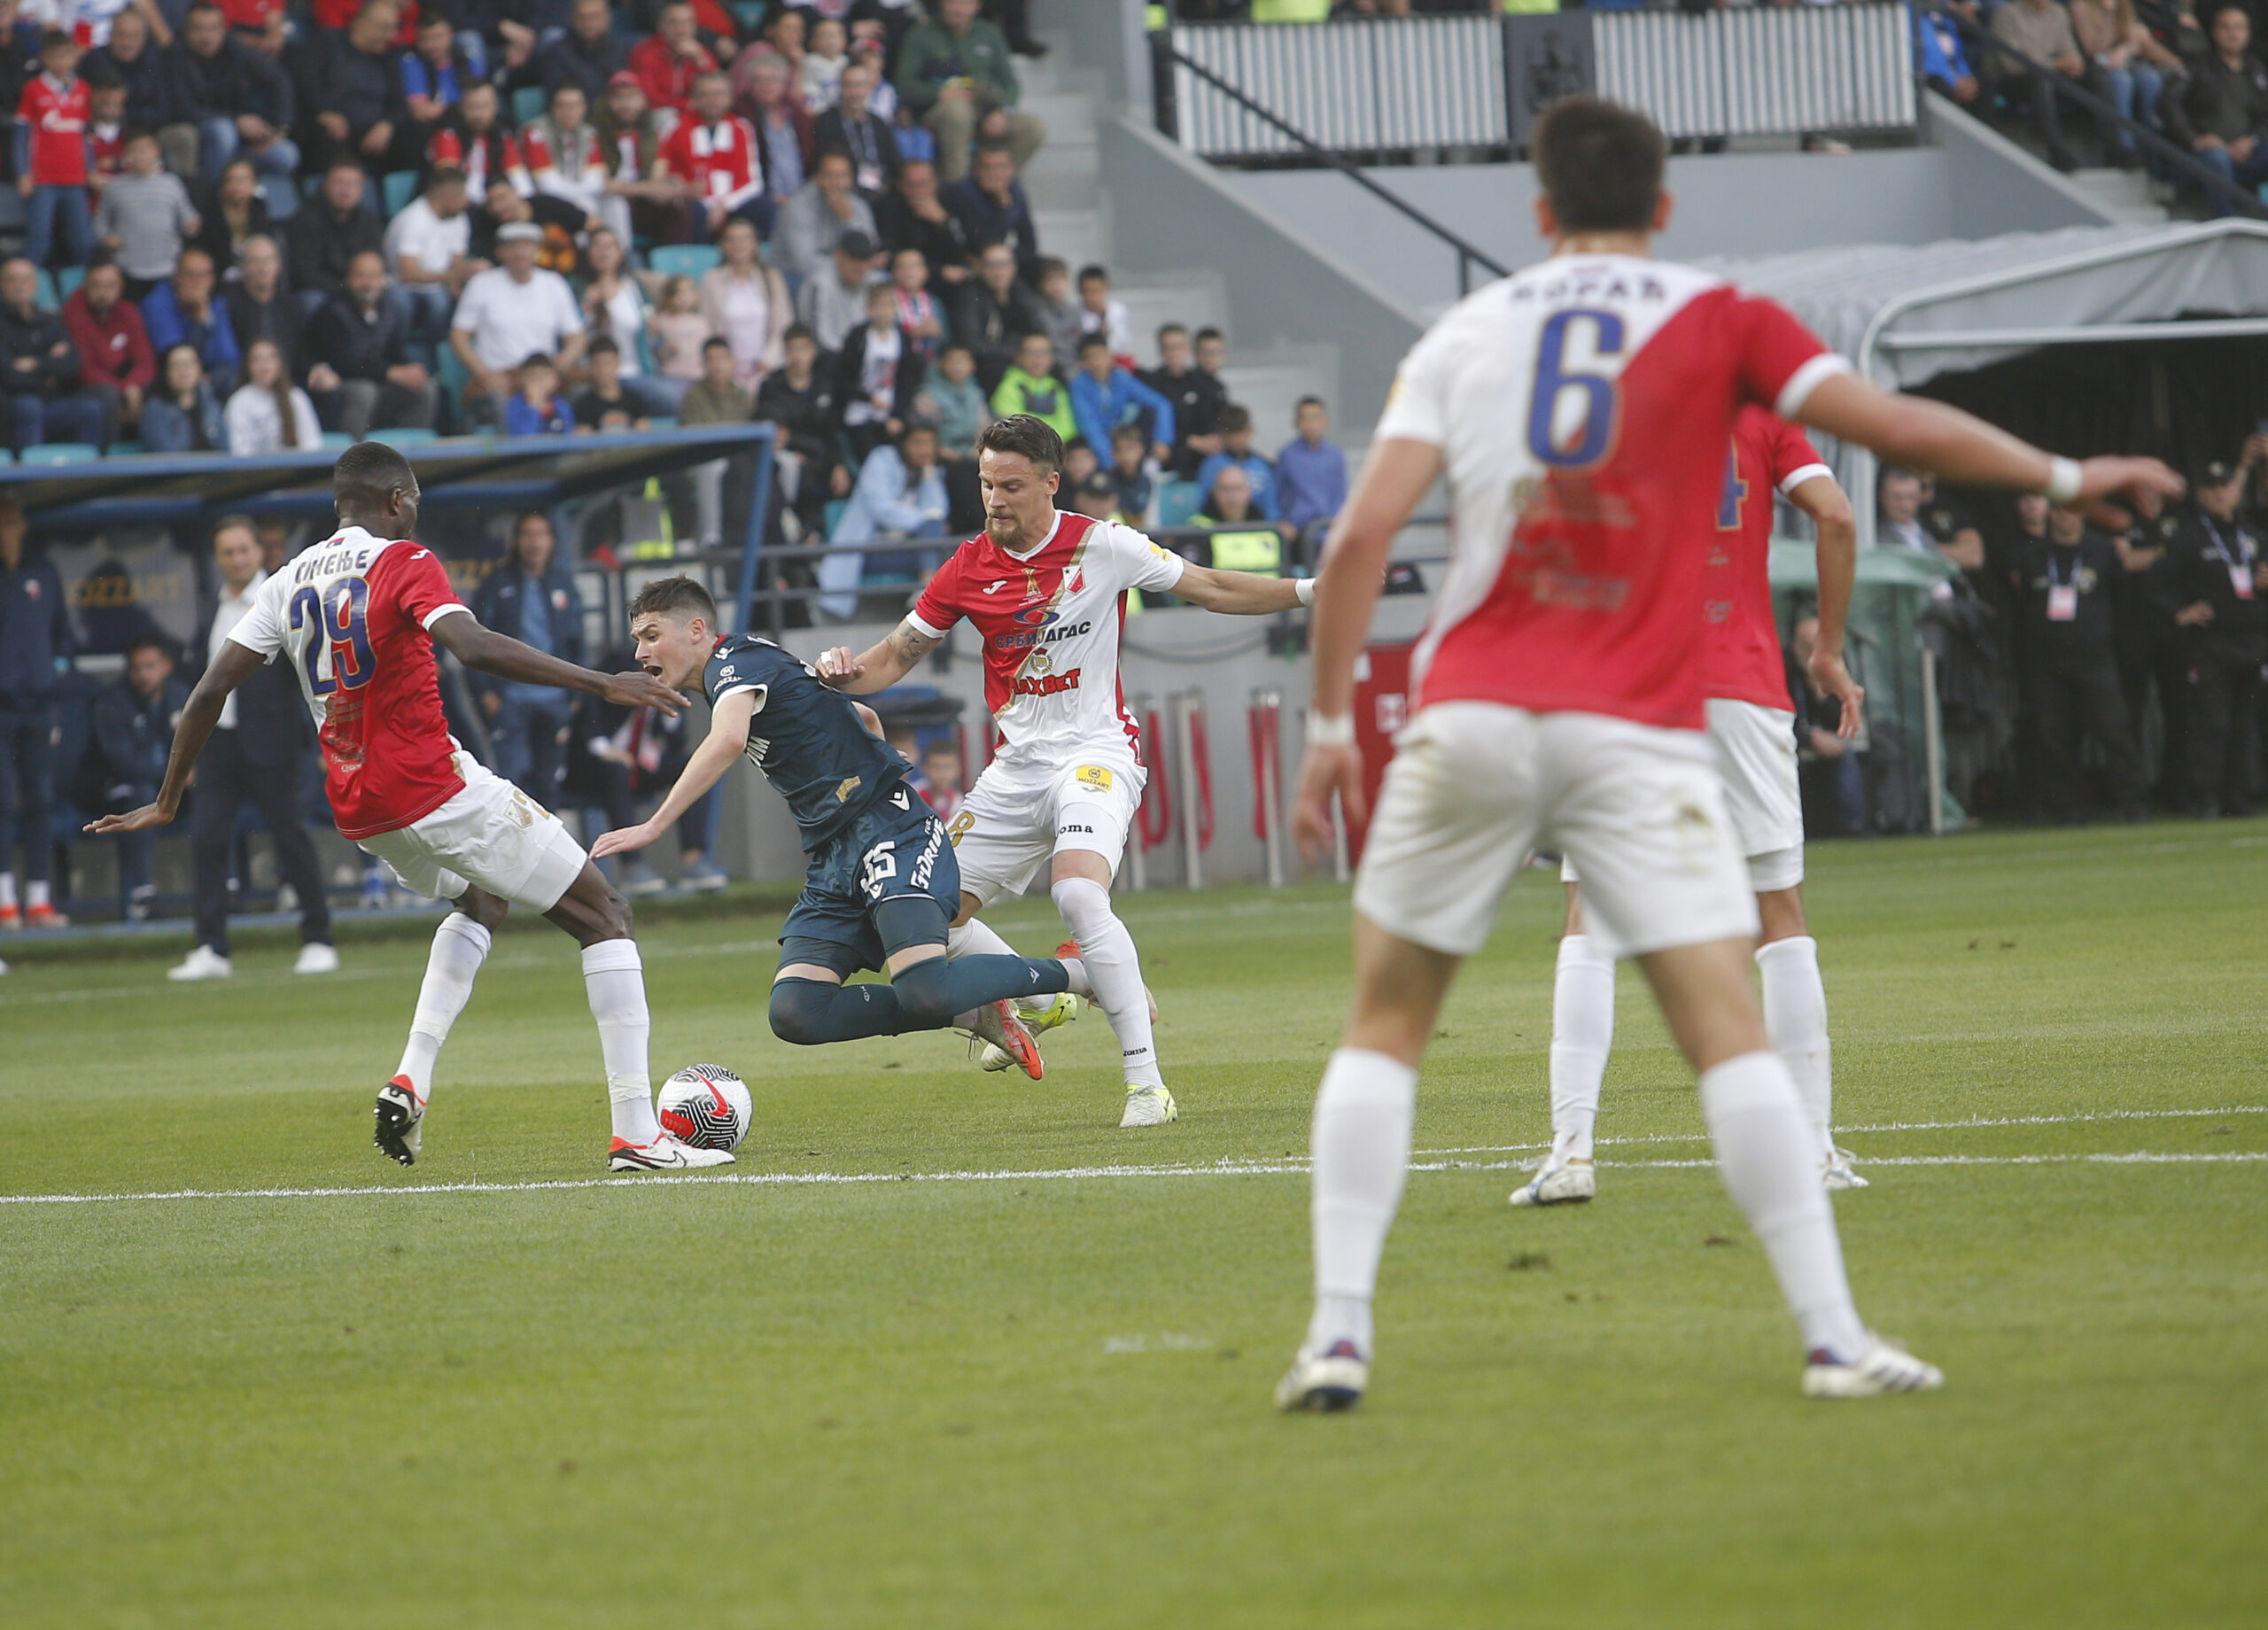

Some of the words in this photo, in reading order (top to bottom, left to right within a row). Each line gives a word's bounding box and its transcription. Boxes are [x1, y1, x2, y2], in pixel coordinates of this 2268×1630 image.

[1527, 307, 1627, 470] 6
[291, 576, 378, 698] 29
[996, 621, 1092, 649] СРБИЈАГАС
[1078, 777, 1109, 789] MOZZART
[1059, 824, 1094, 834] oma
